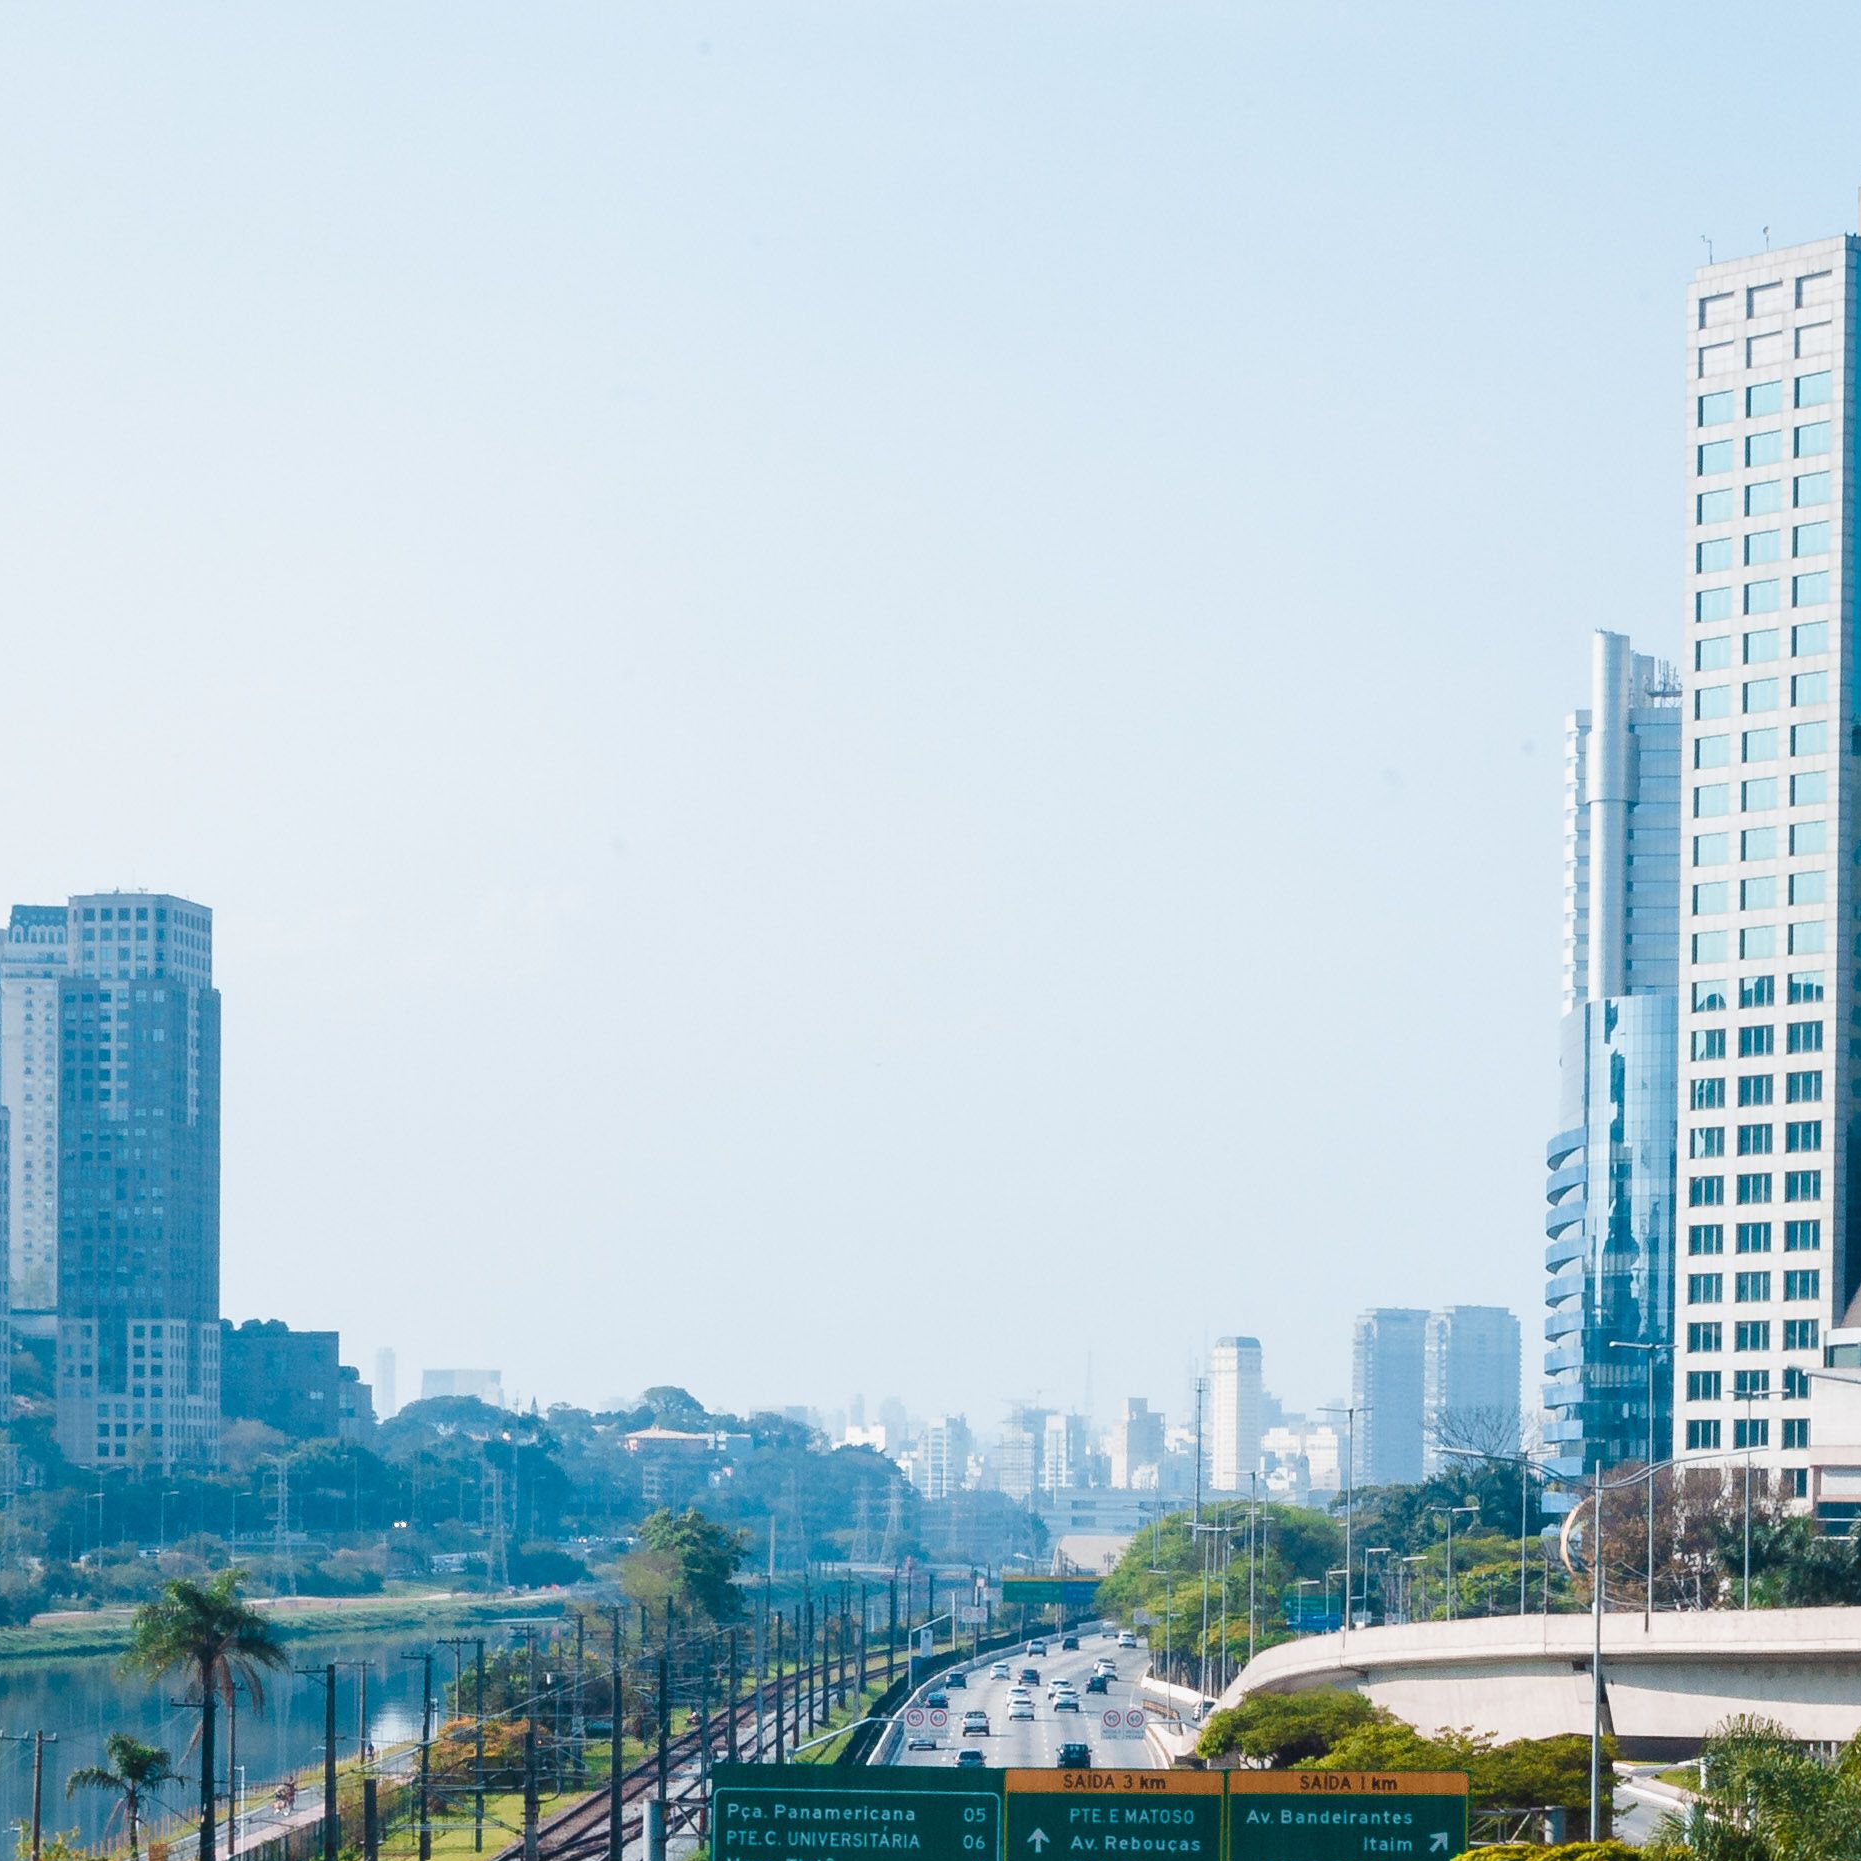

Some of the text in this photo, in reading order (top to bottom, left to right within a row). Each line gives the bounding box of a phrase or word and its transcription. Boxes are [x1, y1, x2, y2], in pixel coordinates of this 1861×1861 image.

[1063, 1773, 1166, 1789] SAÍDA 3 km
[1299, 1774, 1397, 1790] SAÍDA 1 km
[727, 1803, 986, 1822] Pça. Panamericana 05
[1125, 1809, 1195, 1825] MATOSO
[1246, 1808, 1413, 1825] Av. Bandeirantes
[787, 1825, 921, 1849] UNIVERSITÁRIA
[963, 1834, 986, 1849] 06
[1070, 1835, 1201, 1853] Av. Rebouças
[1363, 1836, 1413, 1852] Itaim
